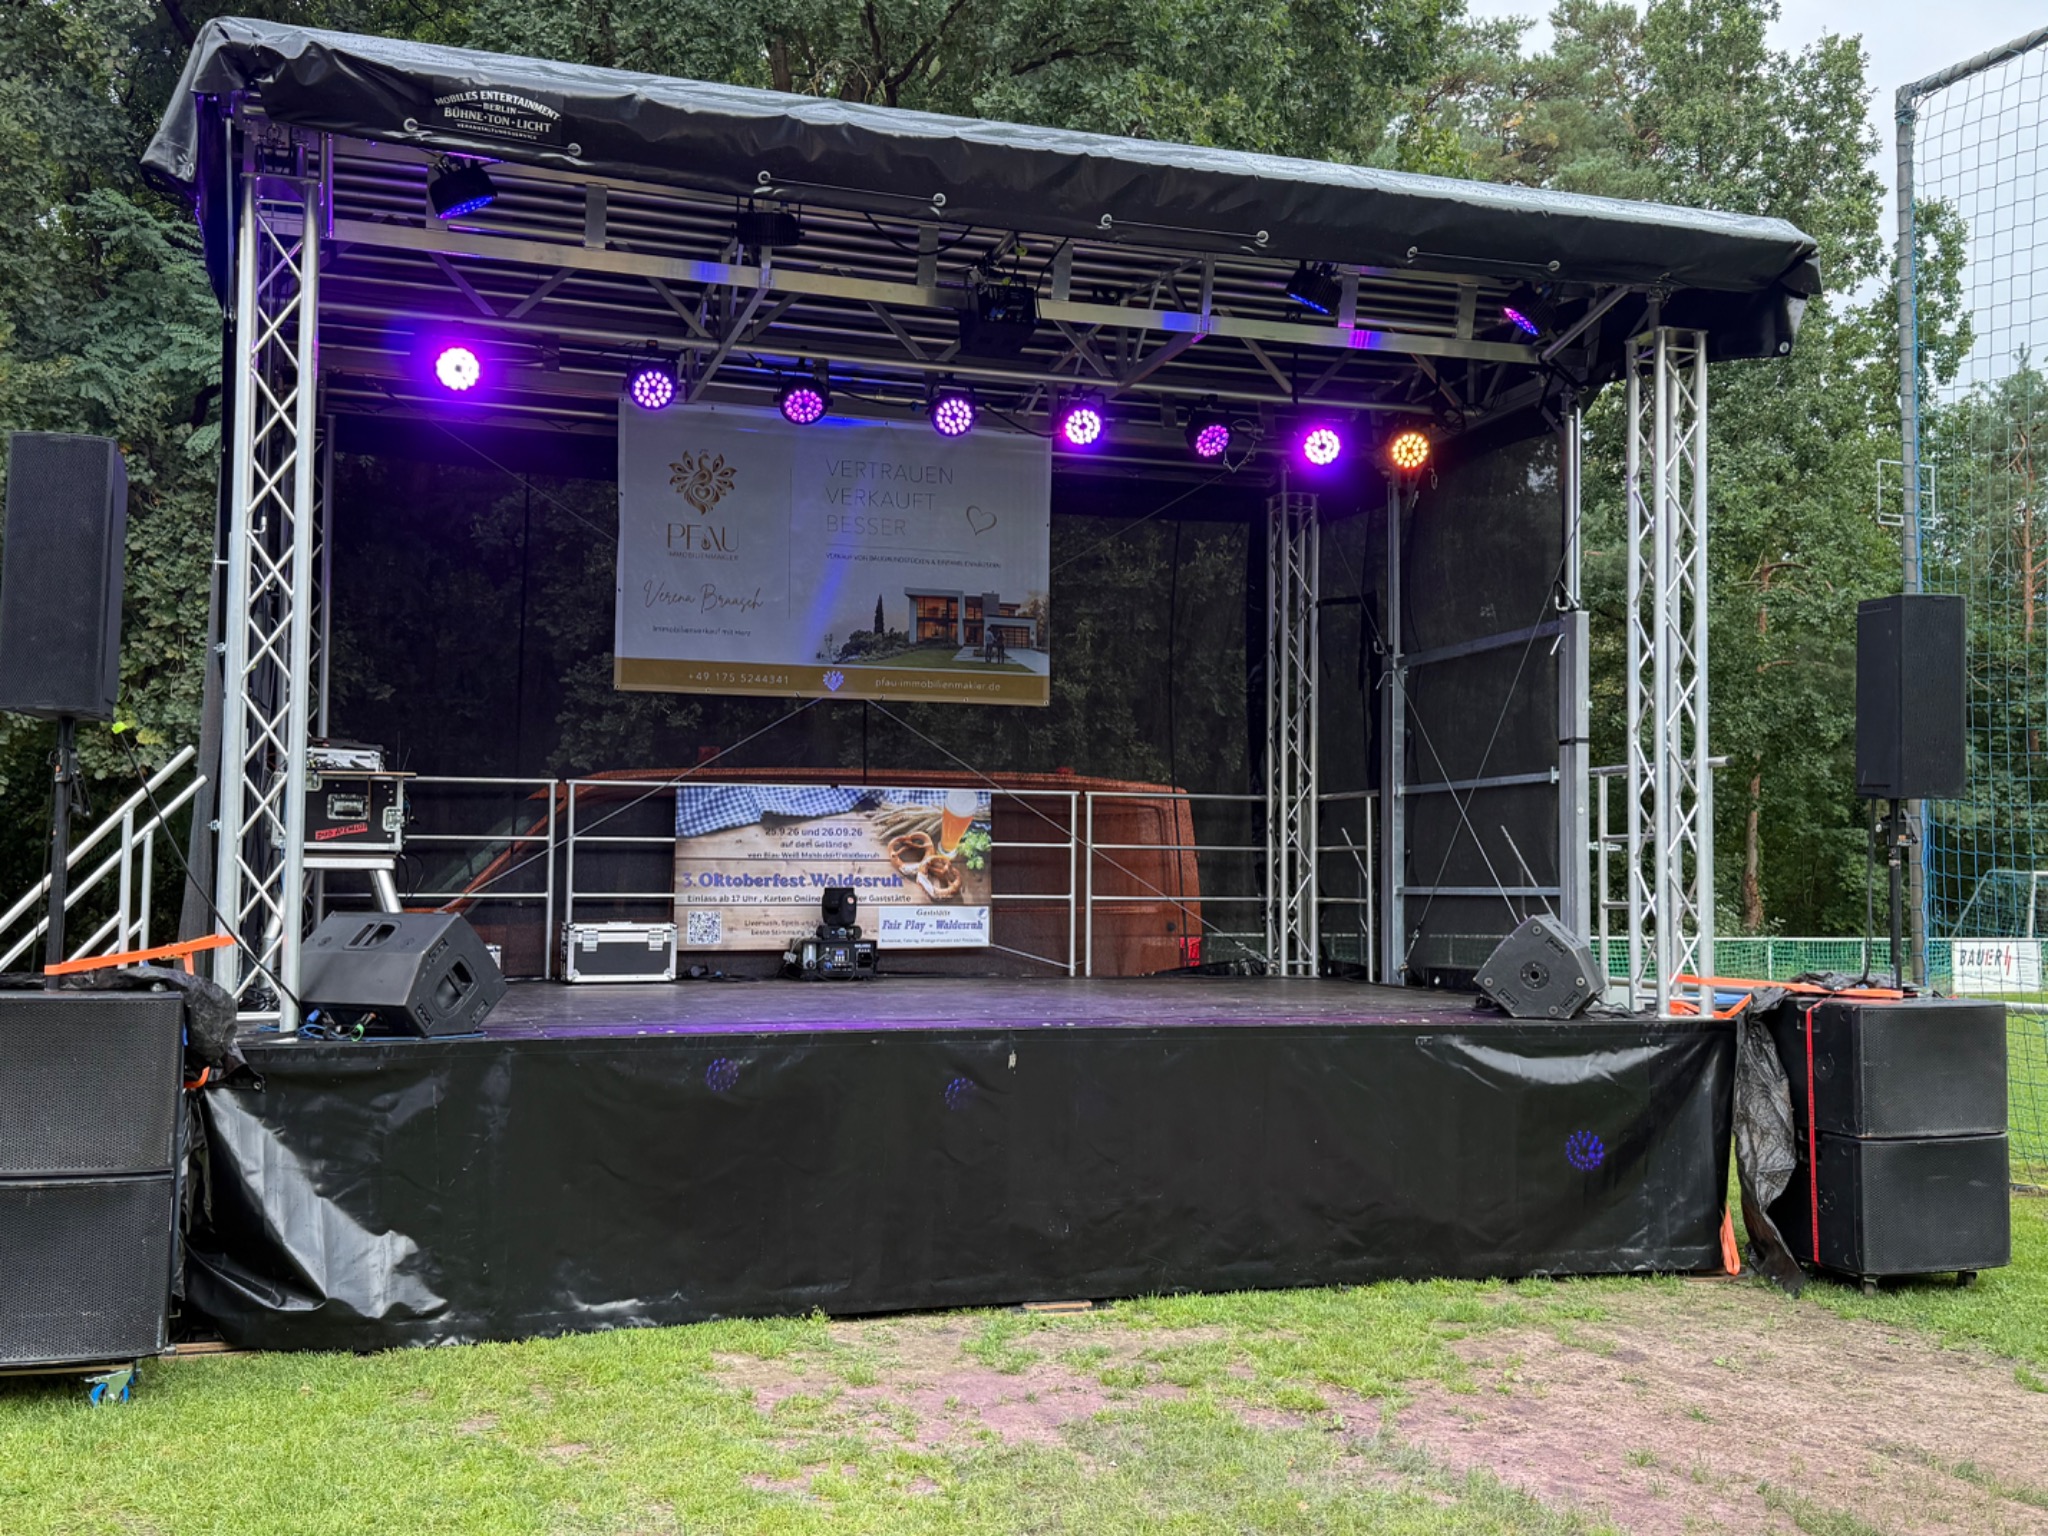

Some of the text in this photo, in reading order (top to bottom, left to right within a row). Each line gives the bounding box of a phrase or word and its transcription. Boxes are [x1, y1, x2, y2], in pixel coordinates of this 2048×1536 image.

[434, 90, 562, 121] MOBILES ENTERTAINMENT
[483, 102, 518, 115] BERLIN
[517, 119, 552, 133] LICHT
[826, 458, 954, 485] VERTRAUEN
[825, 487, 936, 511] VERKAUFT
[827, 514, 906, 536] BESSER
[667, 522, 739, 552] PFAU
[643, 579, 764, 614] Verena Braasch
[688, 671, 709, 681] +49
[715, 672, 735, 683] 175
[801, 827, 819, 837] und
[821, 827, 863, 837] 26.09.26
[780, 840, 793, 848] auf
[682, 872, 904, 888] 3. Oktoberfest Waldesruh
[687, 894, 717, 903] Einlass
[719, 894, 730, 903] ab
[731, 895, 741, 903] 17
[742, 895, 758, 903] Uhr
[764, 894, 792, 903] Karten
[794, 894, 821, 903] Online
[868, 894, 911, 903] Gaststätte
[882, 919, 902, 930] Fair
[904, 919, 926, 932] Play
[936, 919, 984, 930] Waldesruh
[1959, 948, 2003, 966] BAUER
